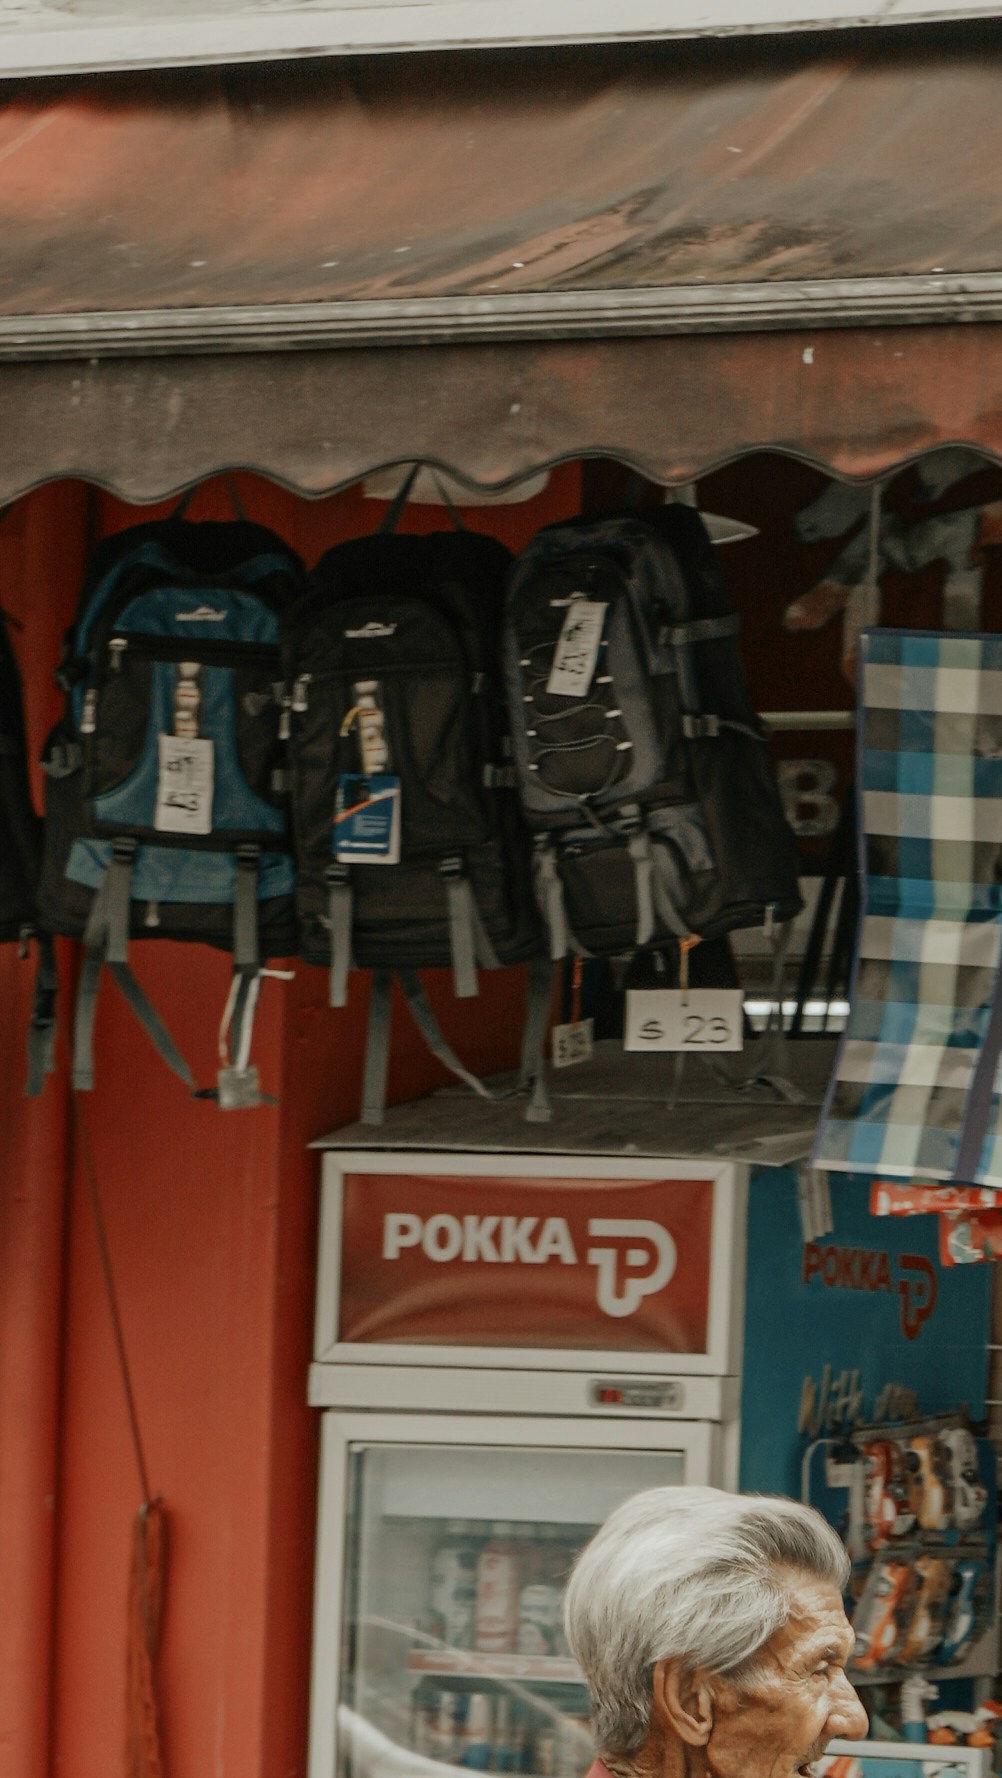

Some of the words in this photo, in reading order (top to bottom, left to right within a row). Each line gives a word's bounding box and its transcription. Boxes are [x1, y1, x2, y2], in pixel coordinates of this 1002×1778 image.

[682, 1014, 731, 1045] 23
[383, 1212, 578, 1265] POKKA
[803, 1243, 893, 1293] POKKA
